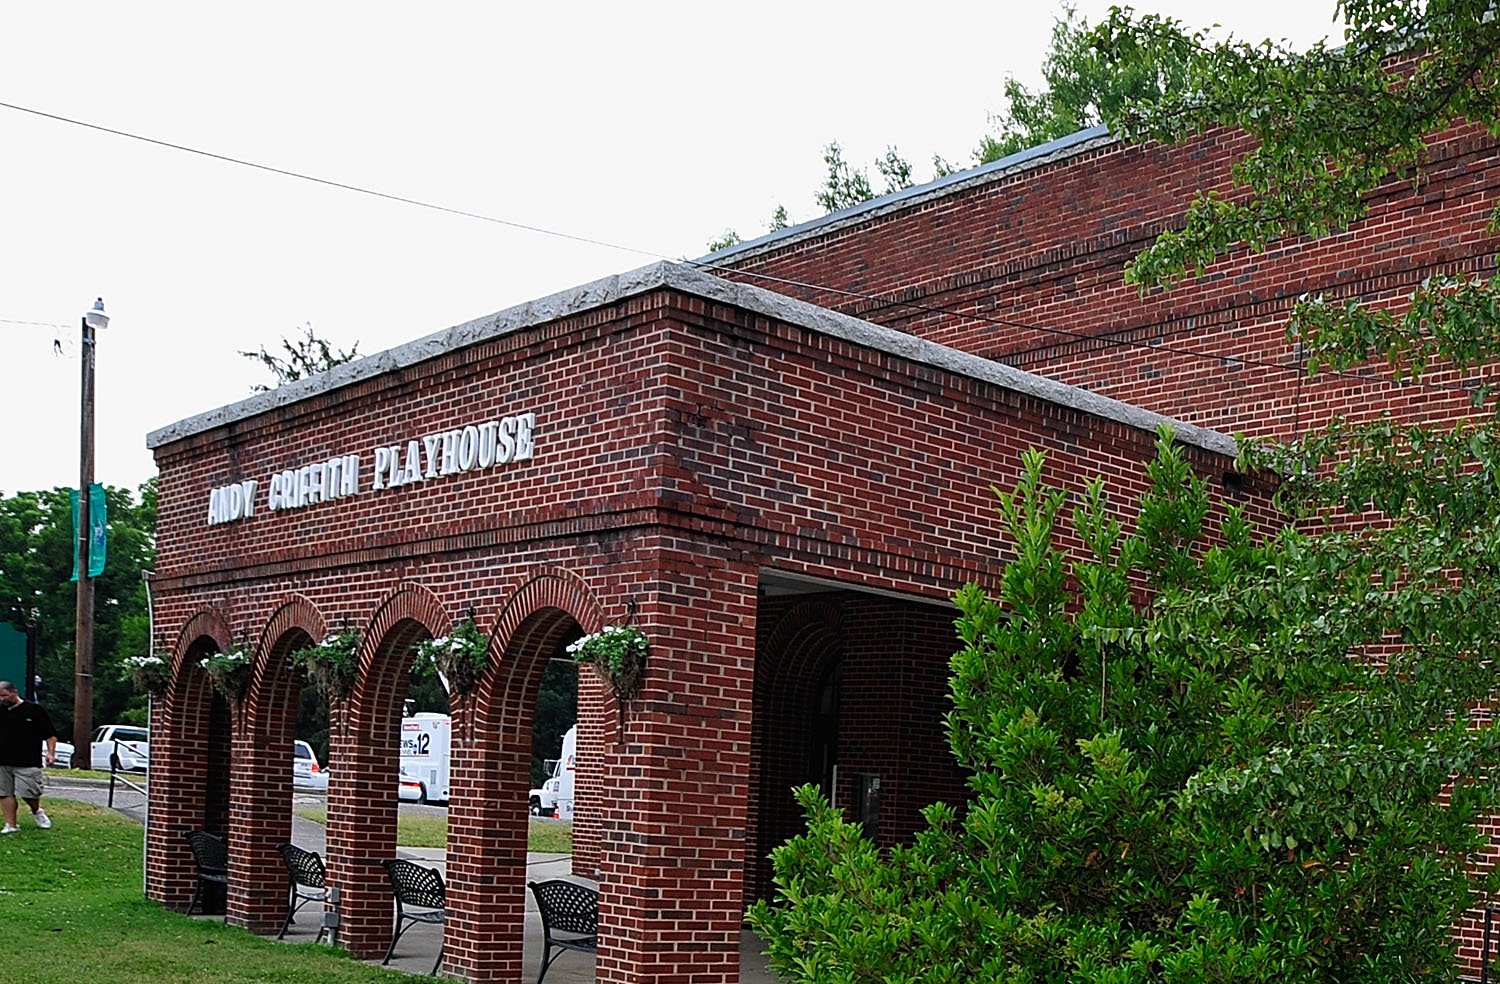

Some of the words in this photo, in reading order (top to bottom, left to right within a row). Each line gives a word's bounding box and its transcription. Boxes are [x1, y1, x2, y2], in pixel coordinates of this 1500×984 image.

[207, 479, 258, 525] ANDY
[268, 454, 360, 511] GRIFFITH
[372, 412, 536, 490] PLAYHOUSE
